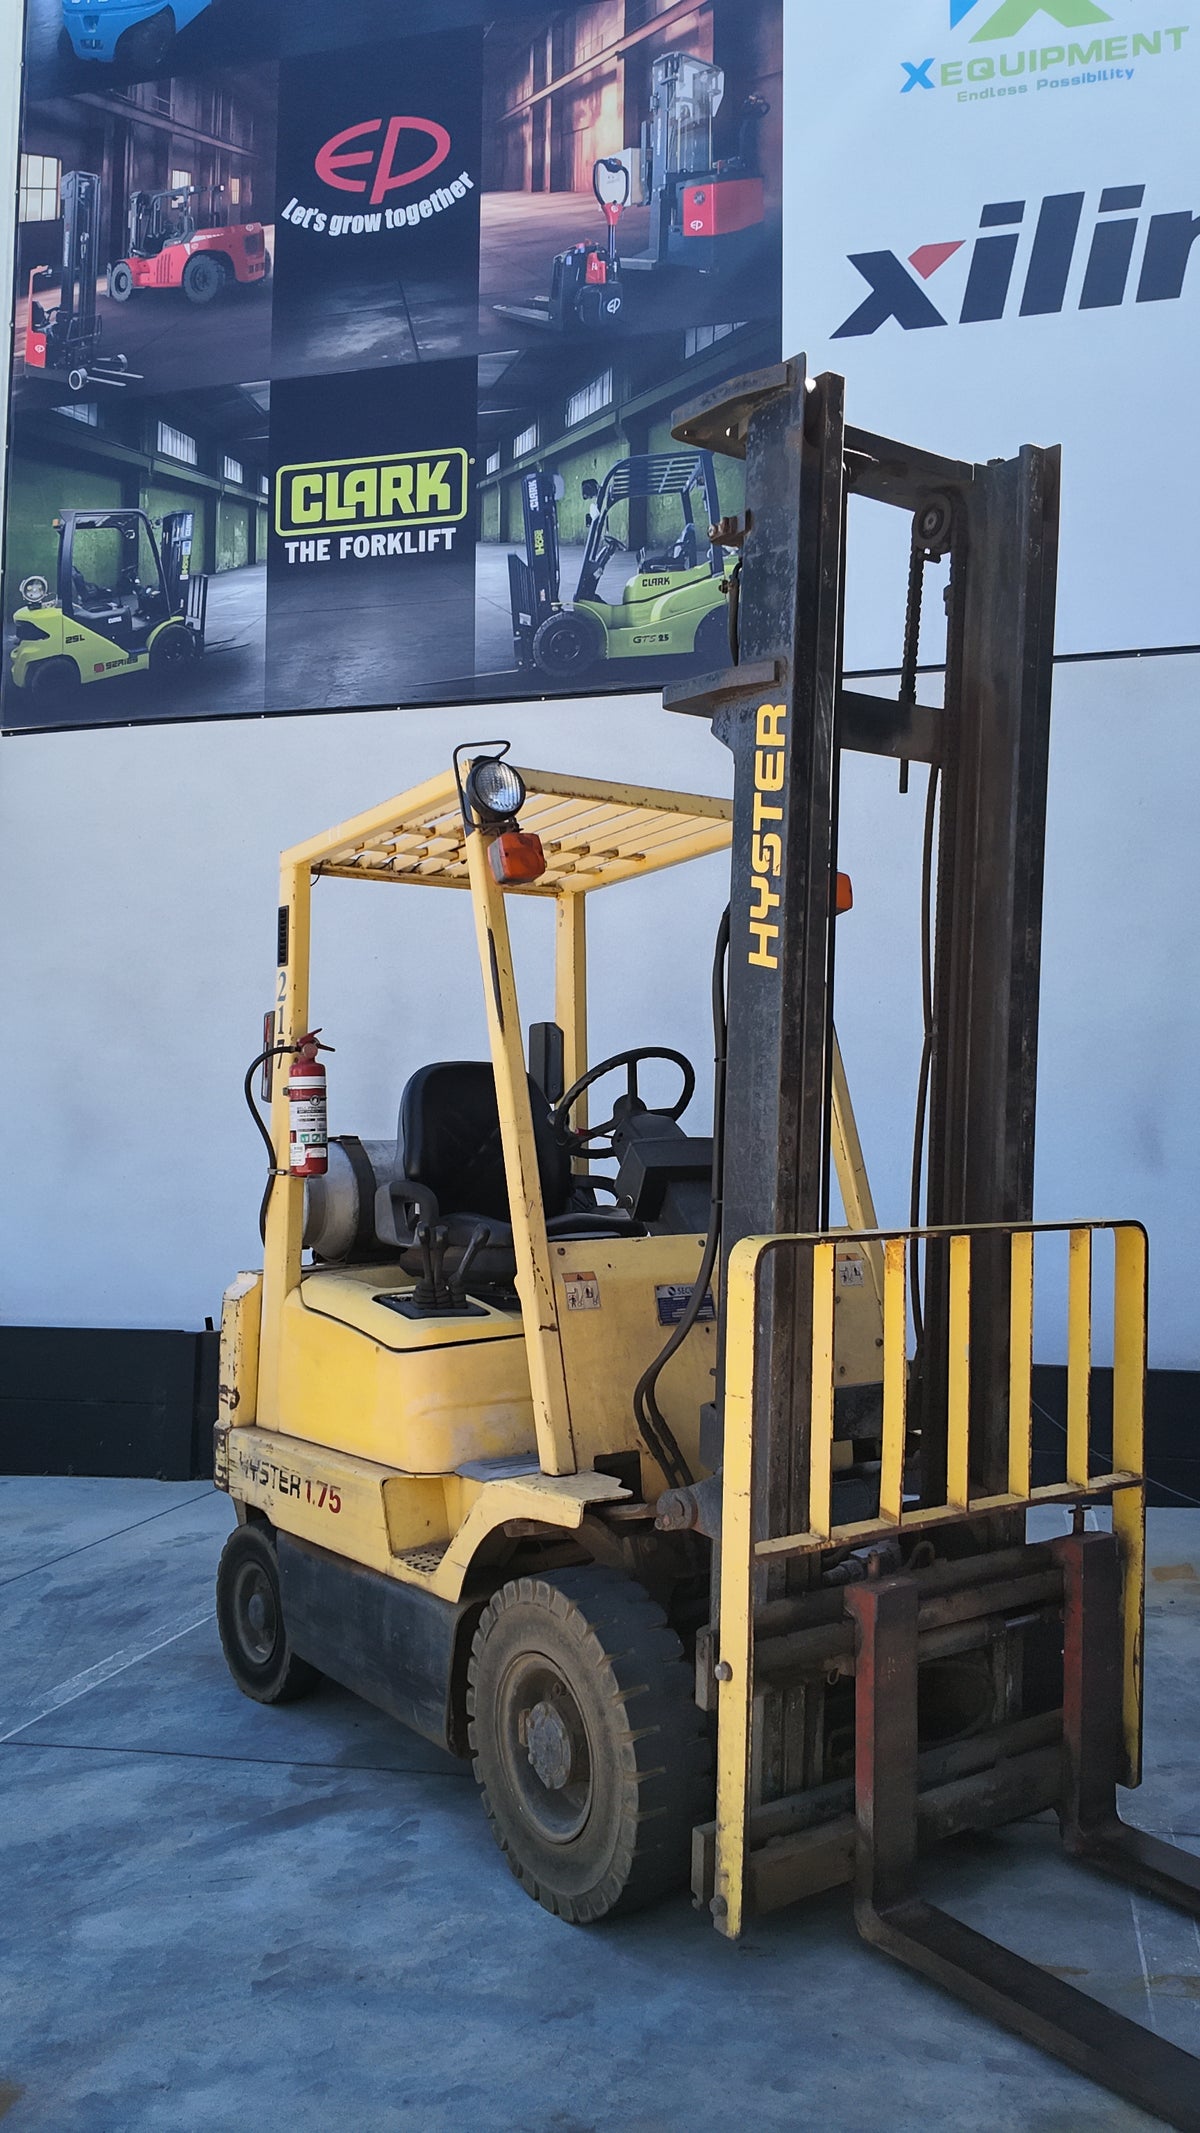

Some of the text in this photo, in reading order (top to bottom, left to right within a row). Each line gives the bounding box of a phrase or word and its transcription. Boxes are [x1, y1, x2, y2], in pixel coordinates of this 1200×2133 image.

[956, 68, 1135, 103] Endless Possibility
[314, 115, 452, 205] EP
[280, 171, 476, 237] Let's grow together
[290, 459, 452, 525] CLARK
[284, 527, 457, 564] THE FORKLIFT
[642, 576, 671, 588] CLARK
[747, 703, 788, 970] HYSTER
[304, 1478, 342, 1515] 1.75
